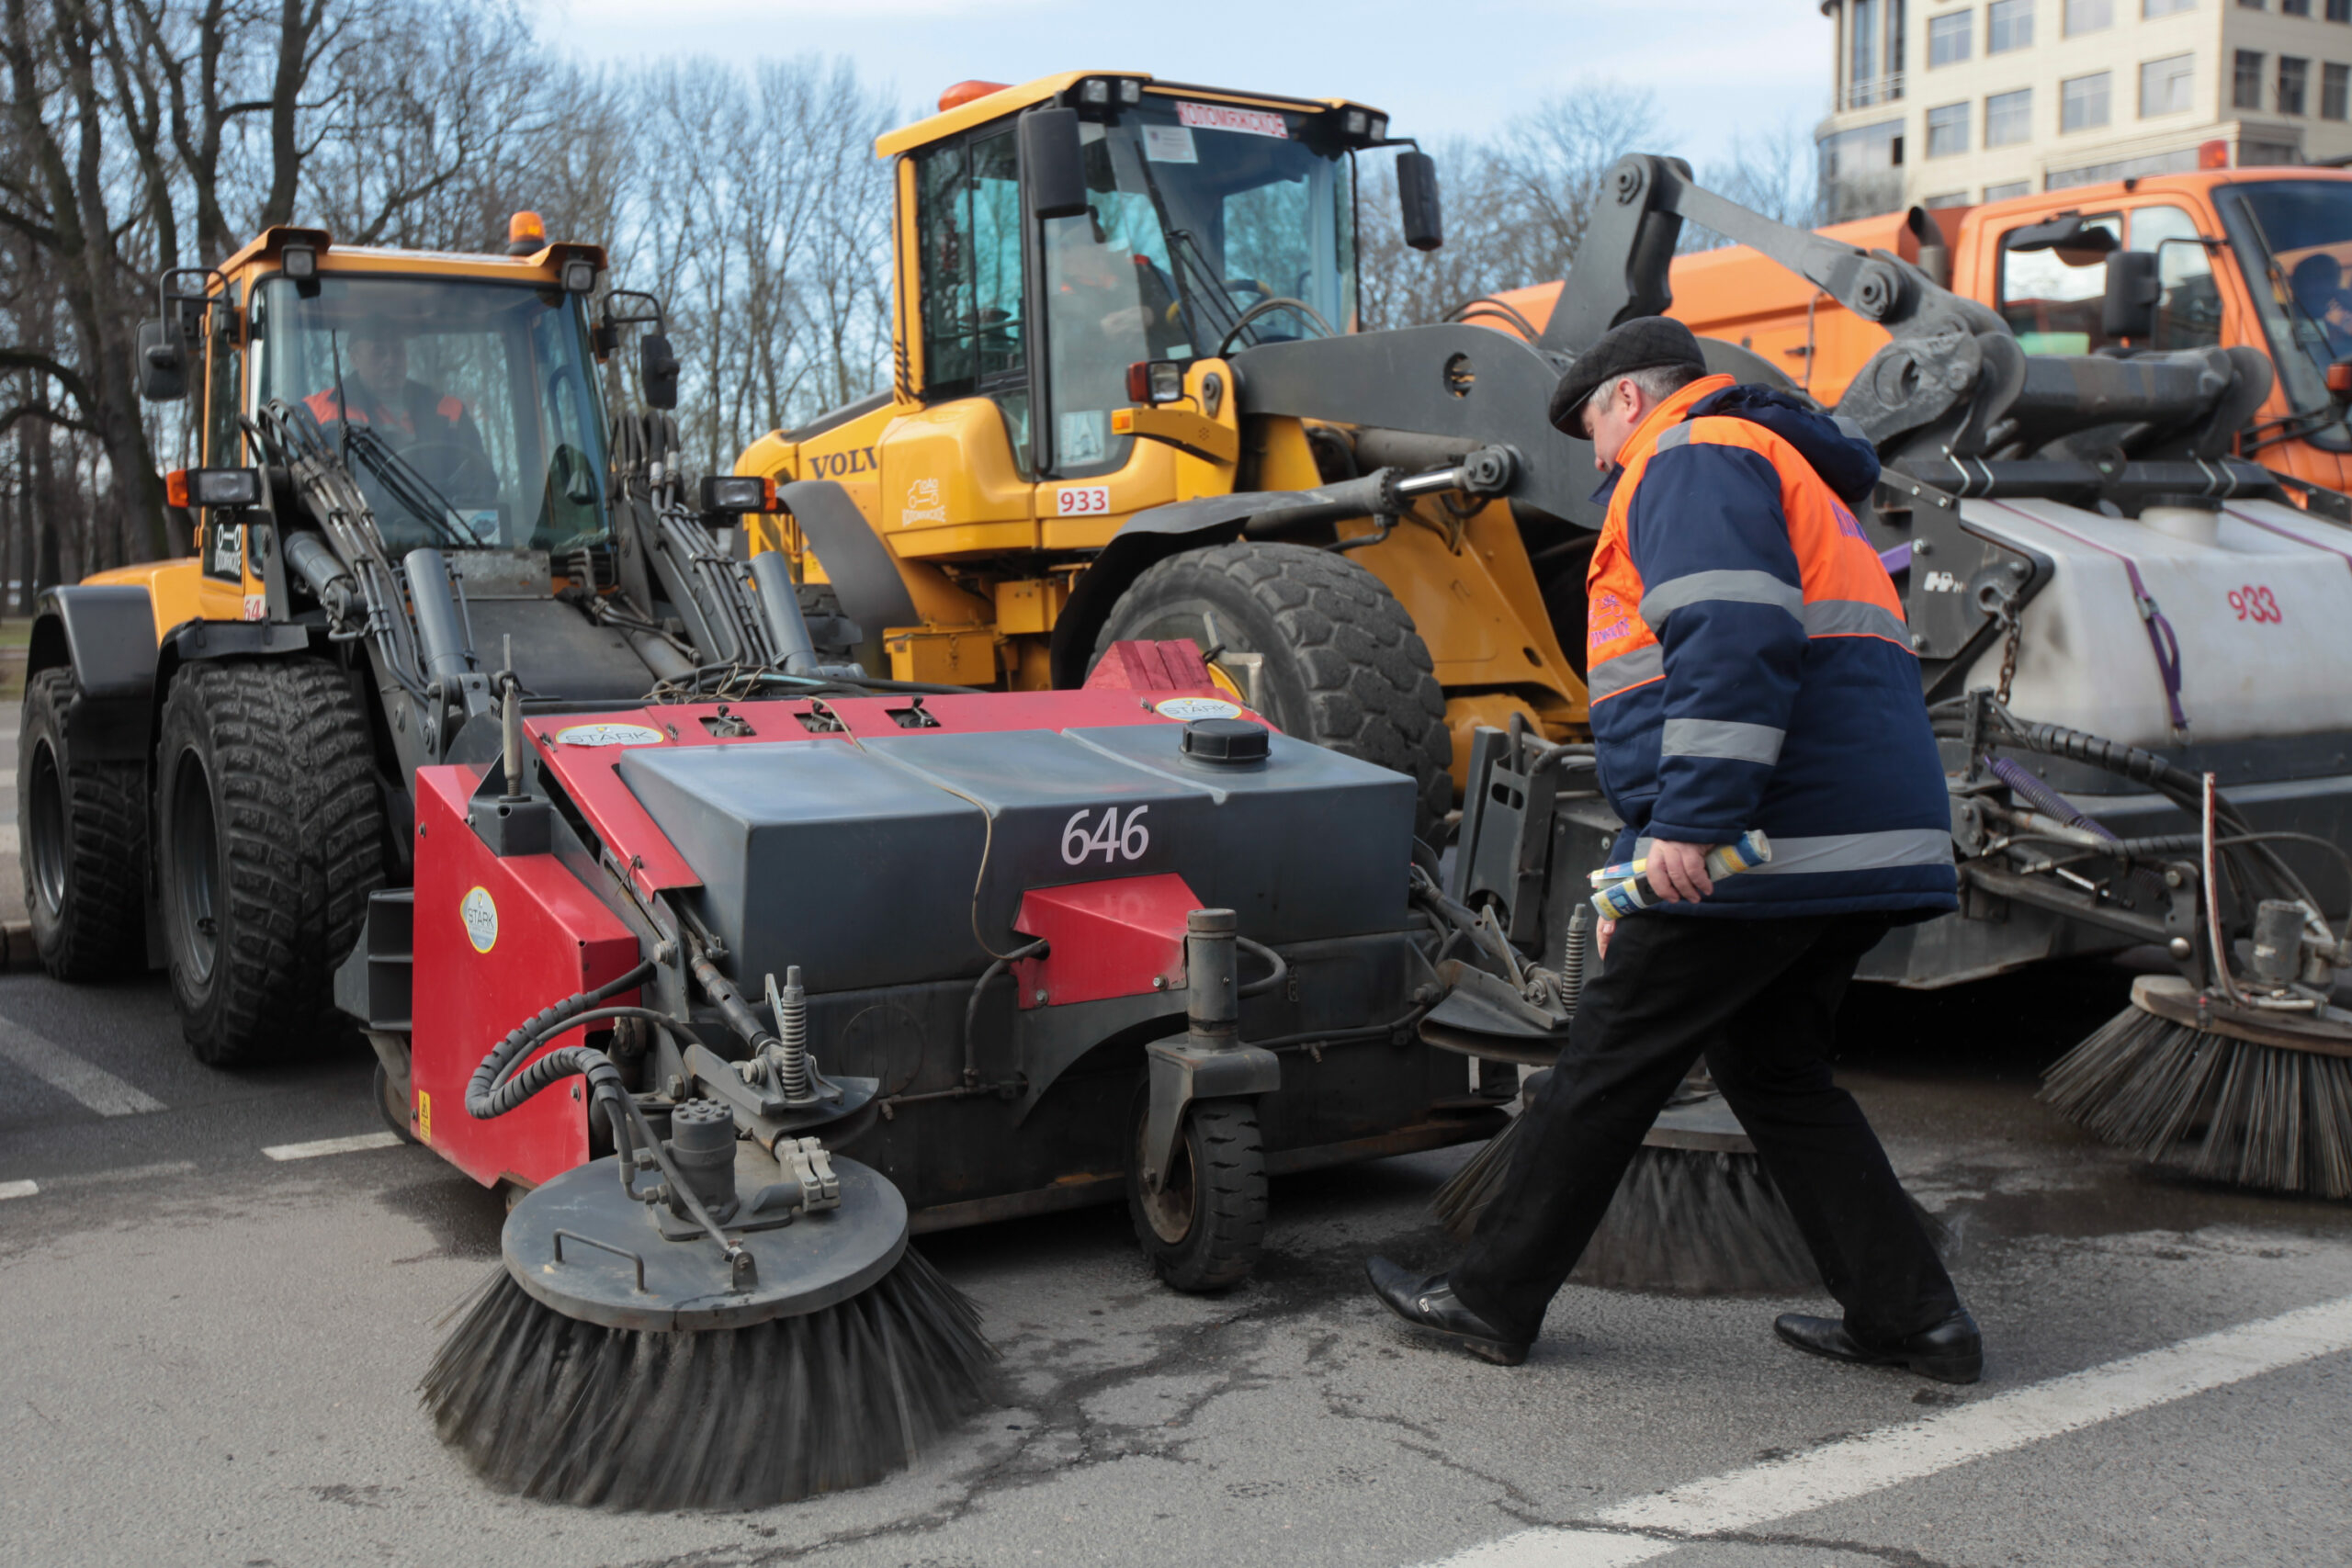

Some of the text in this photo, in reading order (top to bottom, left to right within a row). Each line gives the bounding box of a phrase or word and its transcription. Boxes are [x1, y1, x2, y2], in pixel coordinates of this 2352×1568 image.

[1060, 490, 1106, 513] 933
[244, 599, 266, 621] 64
[2227, 584, 2283, 625] 933
[566, 732, 651, 743] STARK
[1061, 805, 1148, 865] 646
[468, 908, 494, 930] STARK
